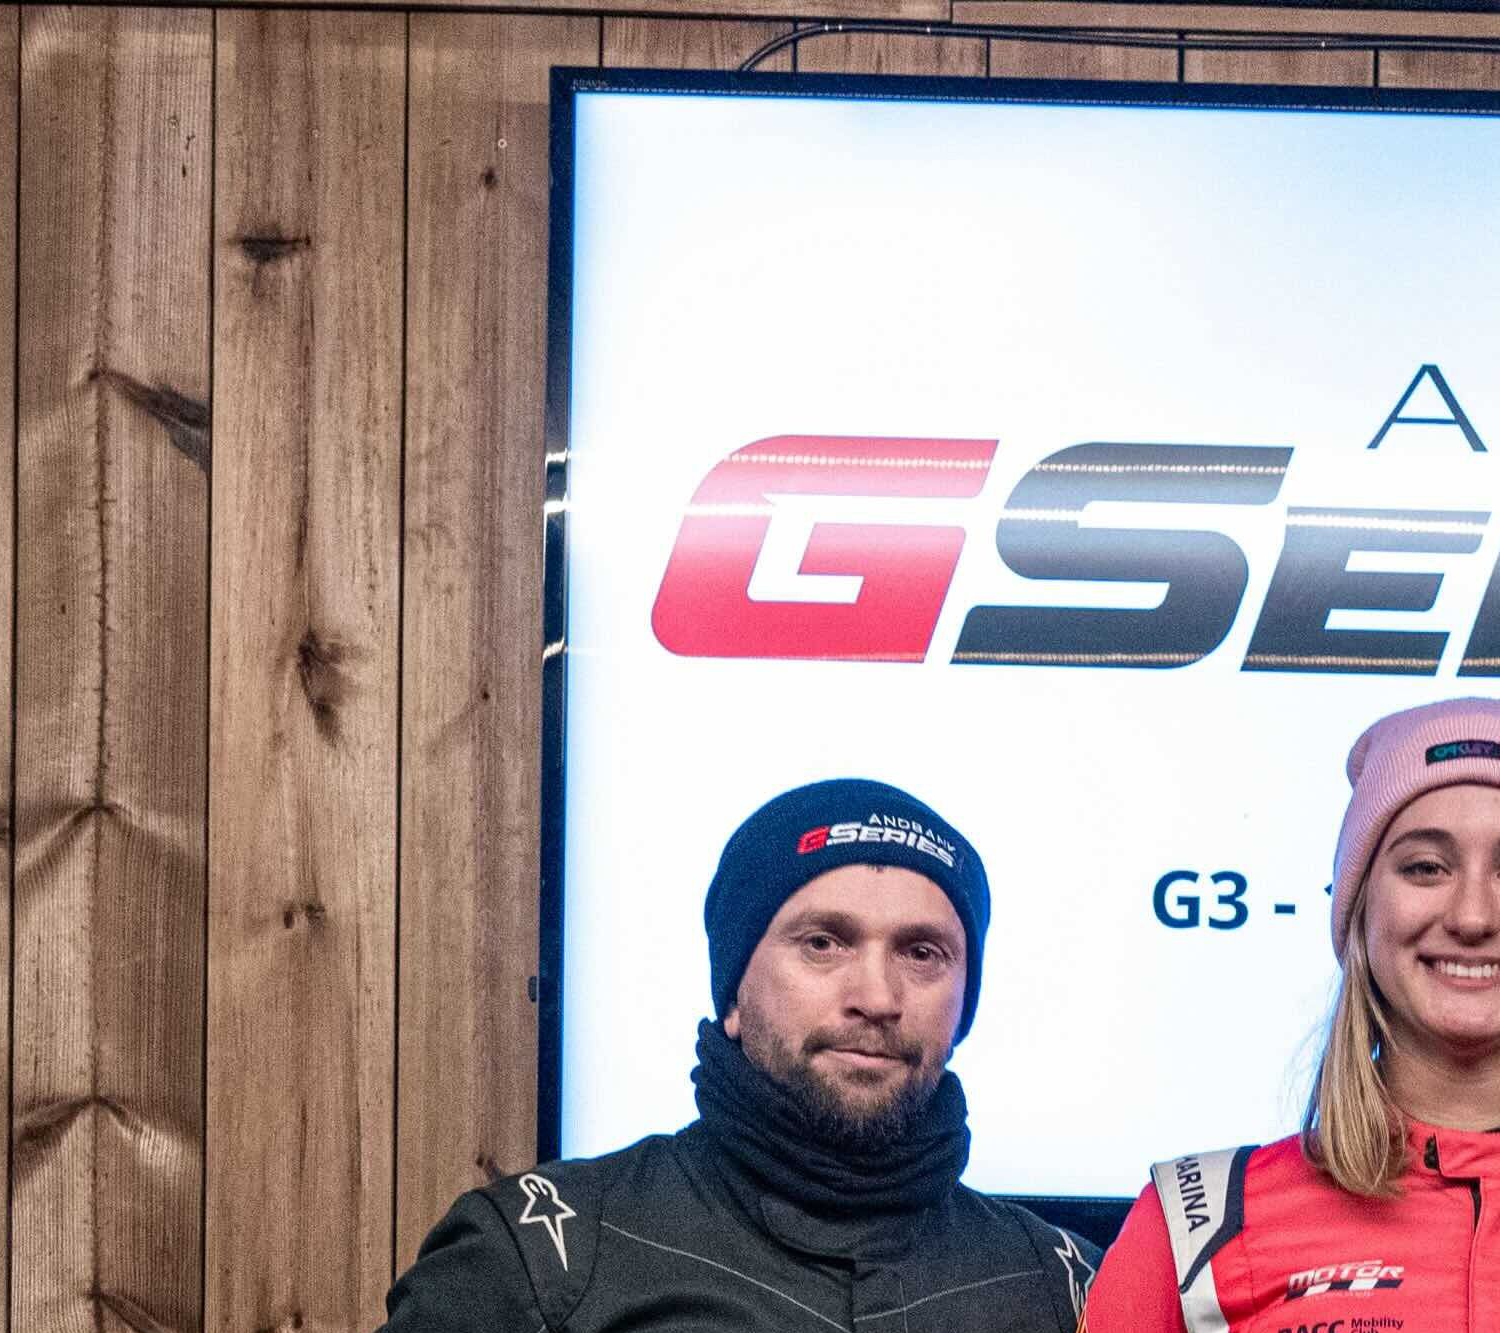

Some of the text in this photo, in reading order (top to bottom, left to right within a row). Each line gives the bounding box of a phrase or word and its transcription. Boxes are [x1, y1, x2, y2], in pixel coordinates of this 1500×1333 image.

[796, 821, 954, 869] GSERIES
[869, 812, 955, 852] ANDBANK
[1153, 870, 1249, 931] G3
[1350, 1316, 1405, 1331] Mobility
